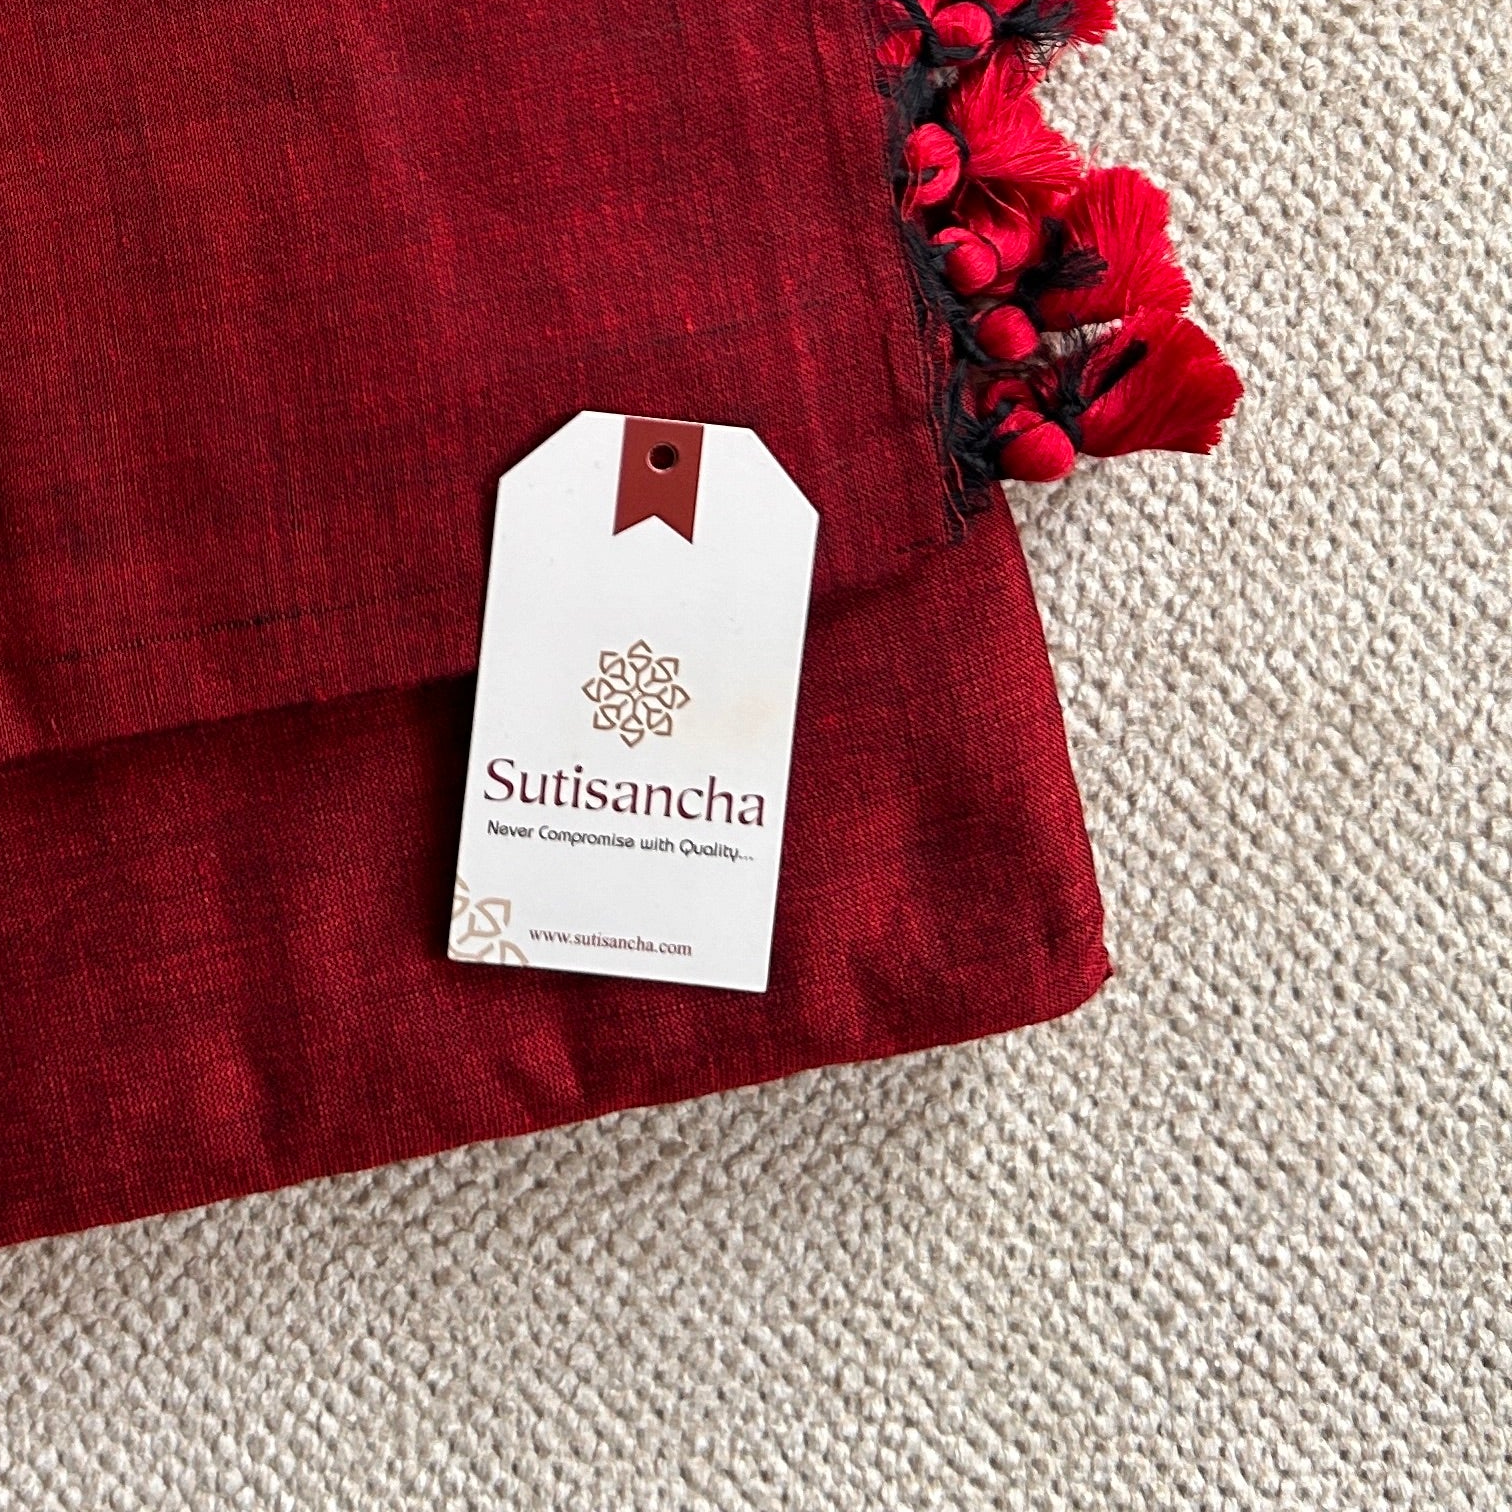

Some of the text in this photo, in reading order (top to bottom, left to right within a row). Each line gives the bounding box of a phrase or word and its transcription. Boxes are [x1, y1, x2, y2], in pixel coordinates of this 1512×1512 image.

[483, 757, 766, 827] Sutisancha
[487, 819, 754, 862] Never Compromise with Quality...
[529, 927, 693, 957] www.sutisancha.com
